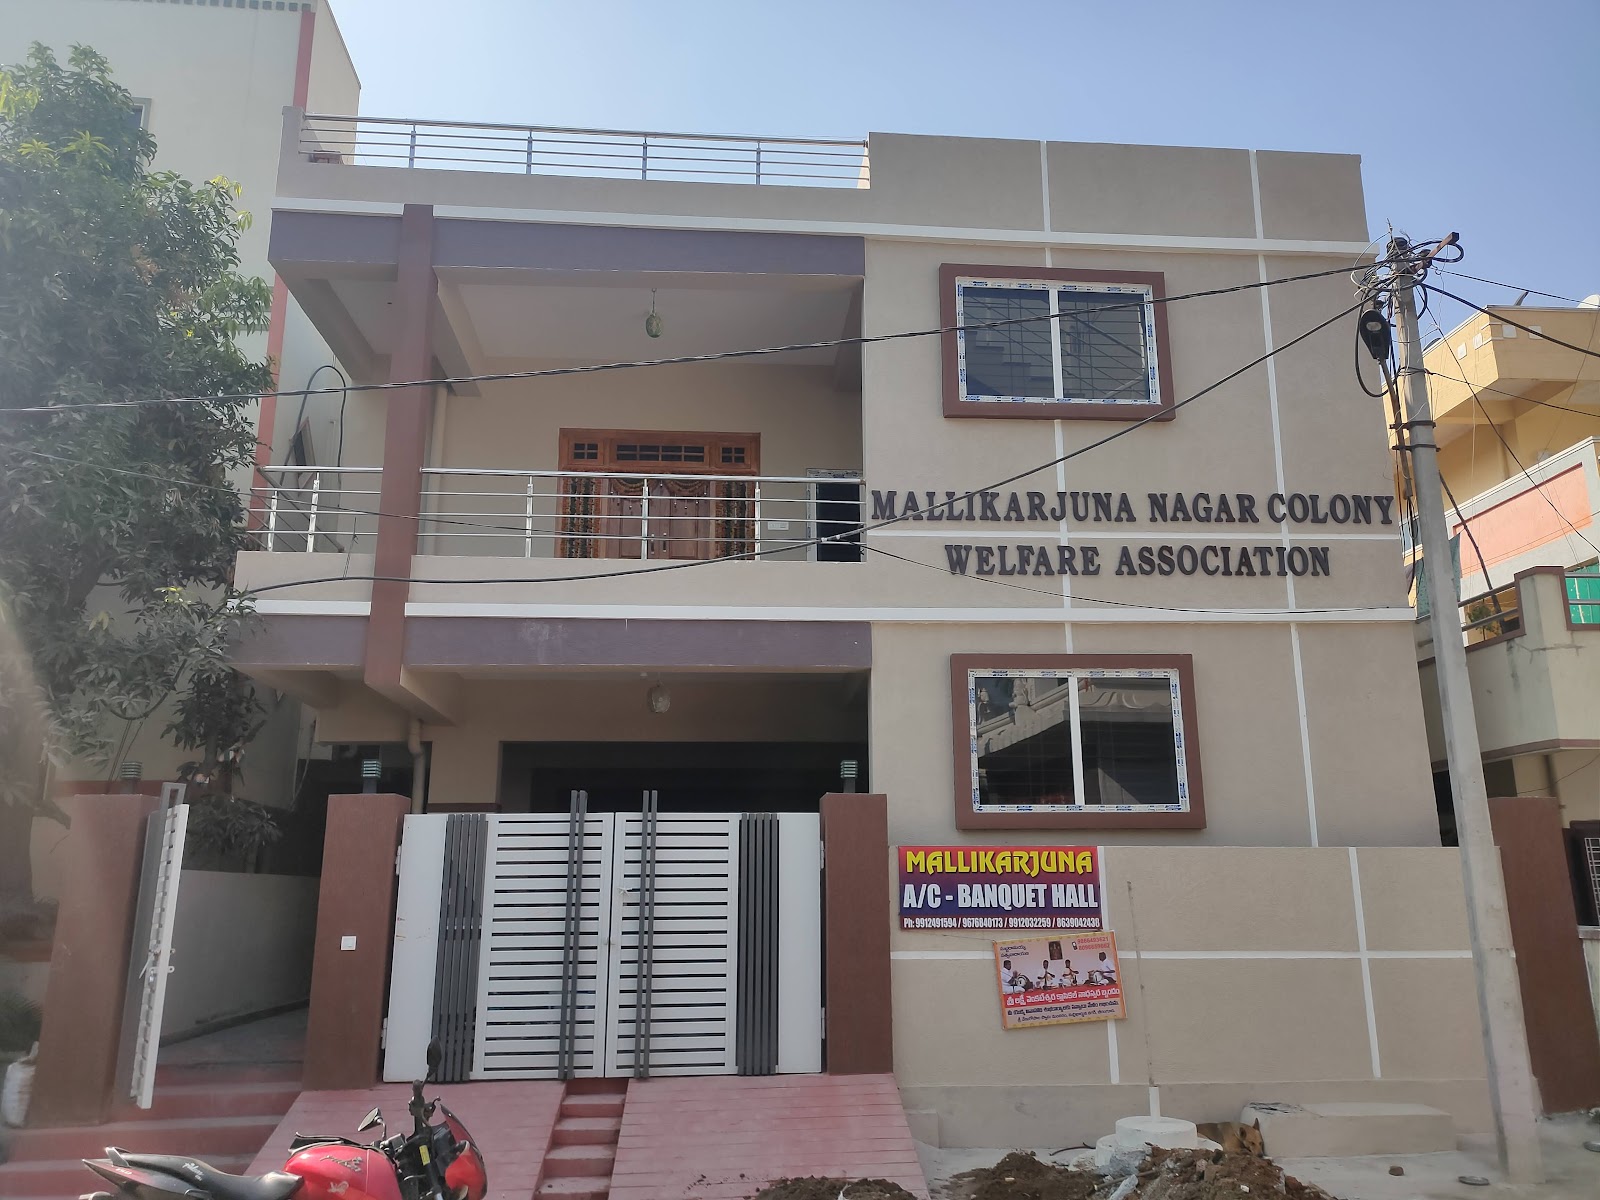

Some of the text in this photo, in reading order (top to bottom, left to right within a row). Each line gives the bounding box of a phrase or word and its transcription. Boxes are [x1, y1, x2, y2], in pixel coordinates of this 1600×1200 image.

[871, 490, 1394, 525] MALLIKARJUNA NAGAR COLONY
[945, 544, 1330, 576] WELFARE ASSOCIATION
[906, 851, 1092, 877] MALLIKARJUNA
[903, 883, 941, 908] A/C
[957, 883, 1048, 910] BANQUET
[1052, 883, 1099, 908] HALL
